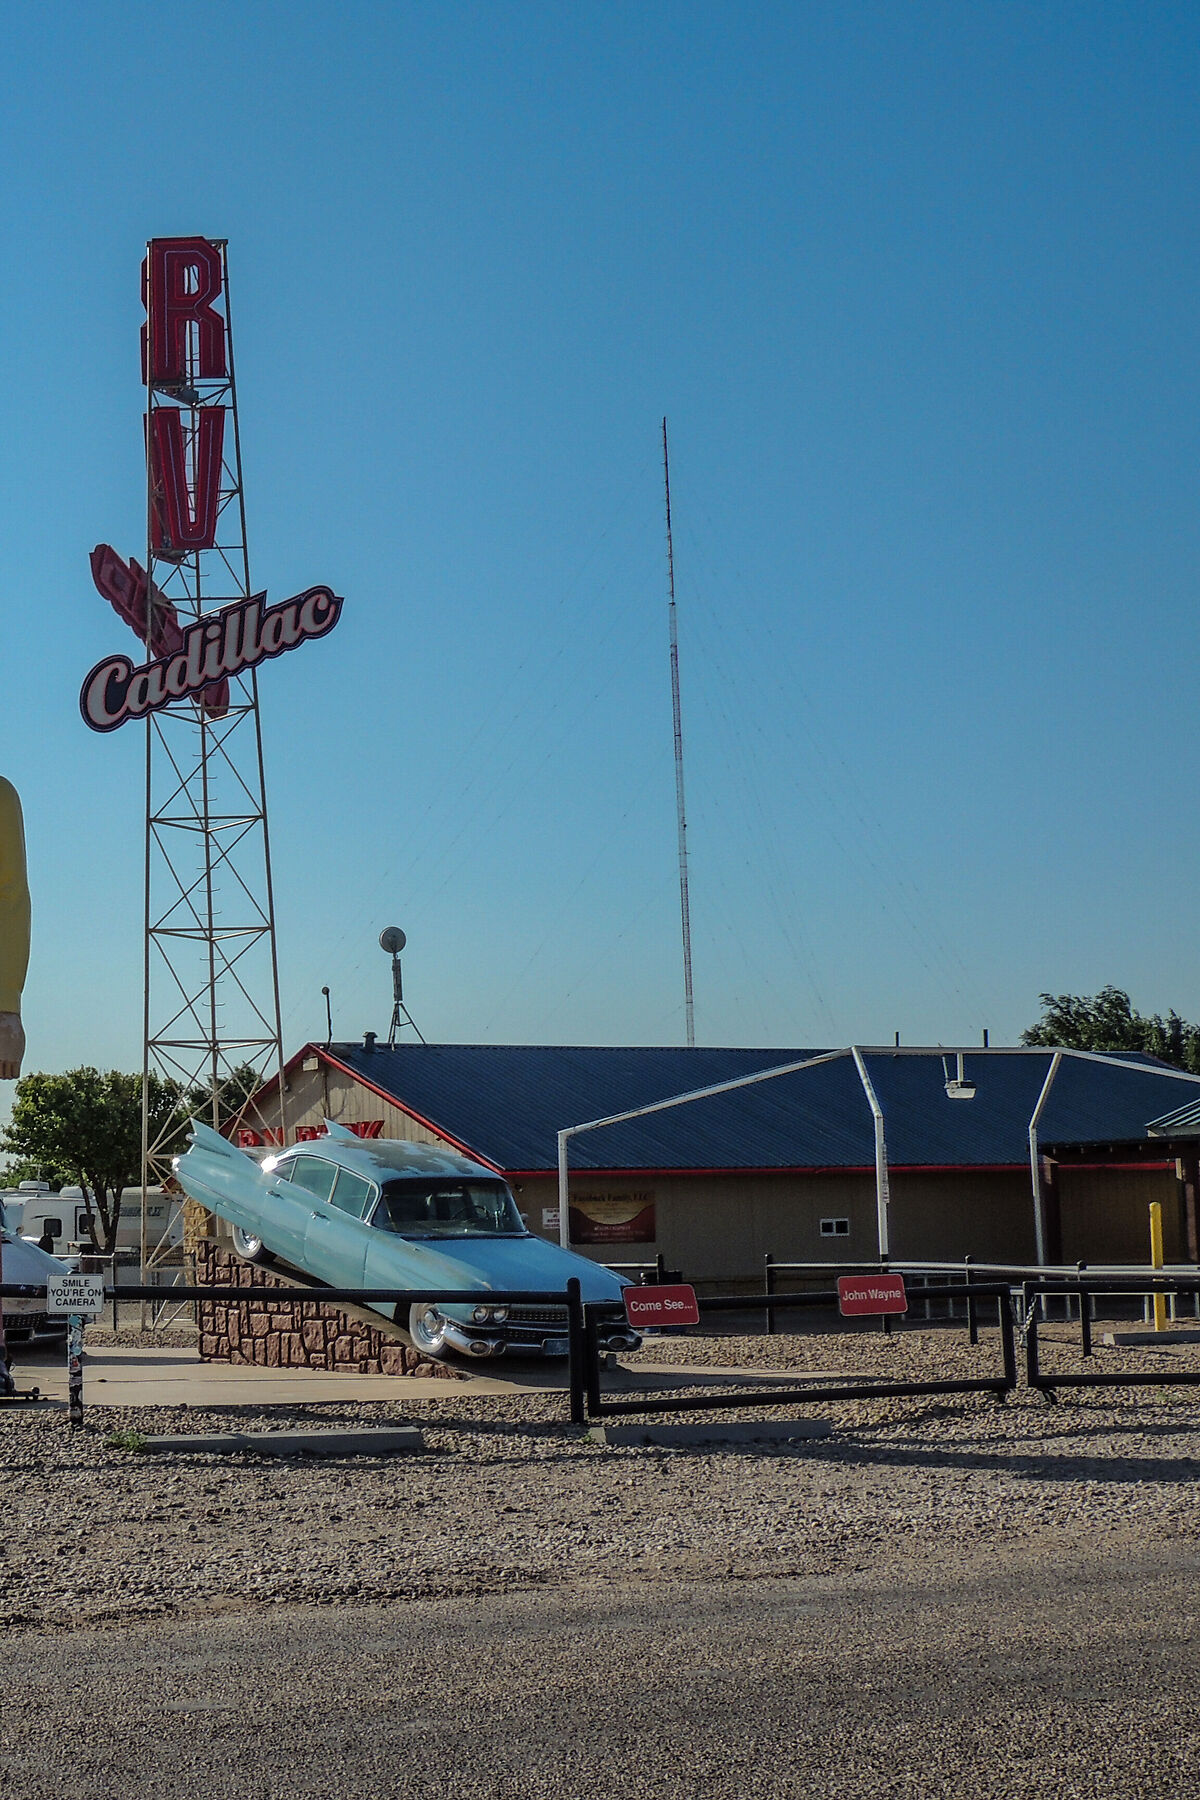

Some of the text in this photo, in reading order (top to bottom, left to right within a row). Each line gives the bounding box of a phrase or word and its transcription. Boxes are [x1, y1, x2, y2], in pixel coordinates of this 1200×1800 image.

[151, 236, 226, 550] RV
[84, 592, 340, 727] Cadillac
[62, 1279, 90, 1288] SMILE
[50, 1288, 102, 1297] YOU'RE ON
[842, 1288, 902, 1302] John Wayne
[55, 1298, 96, 1306] CAMERA
[630, 1301, 662, 1312] Come
